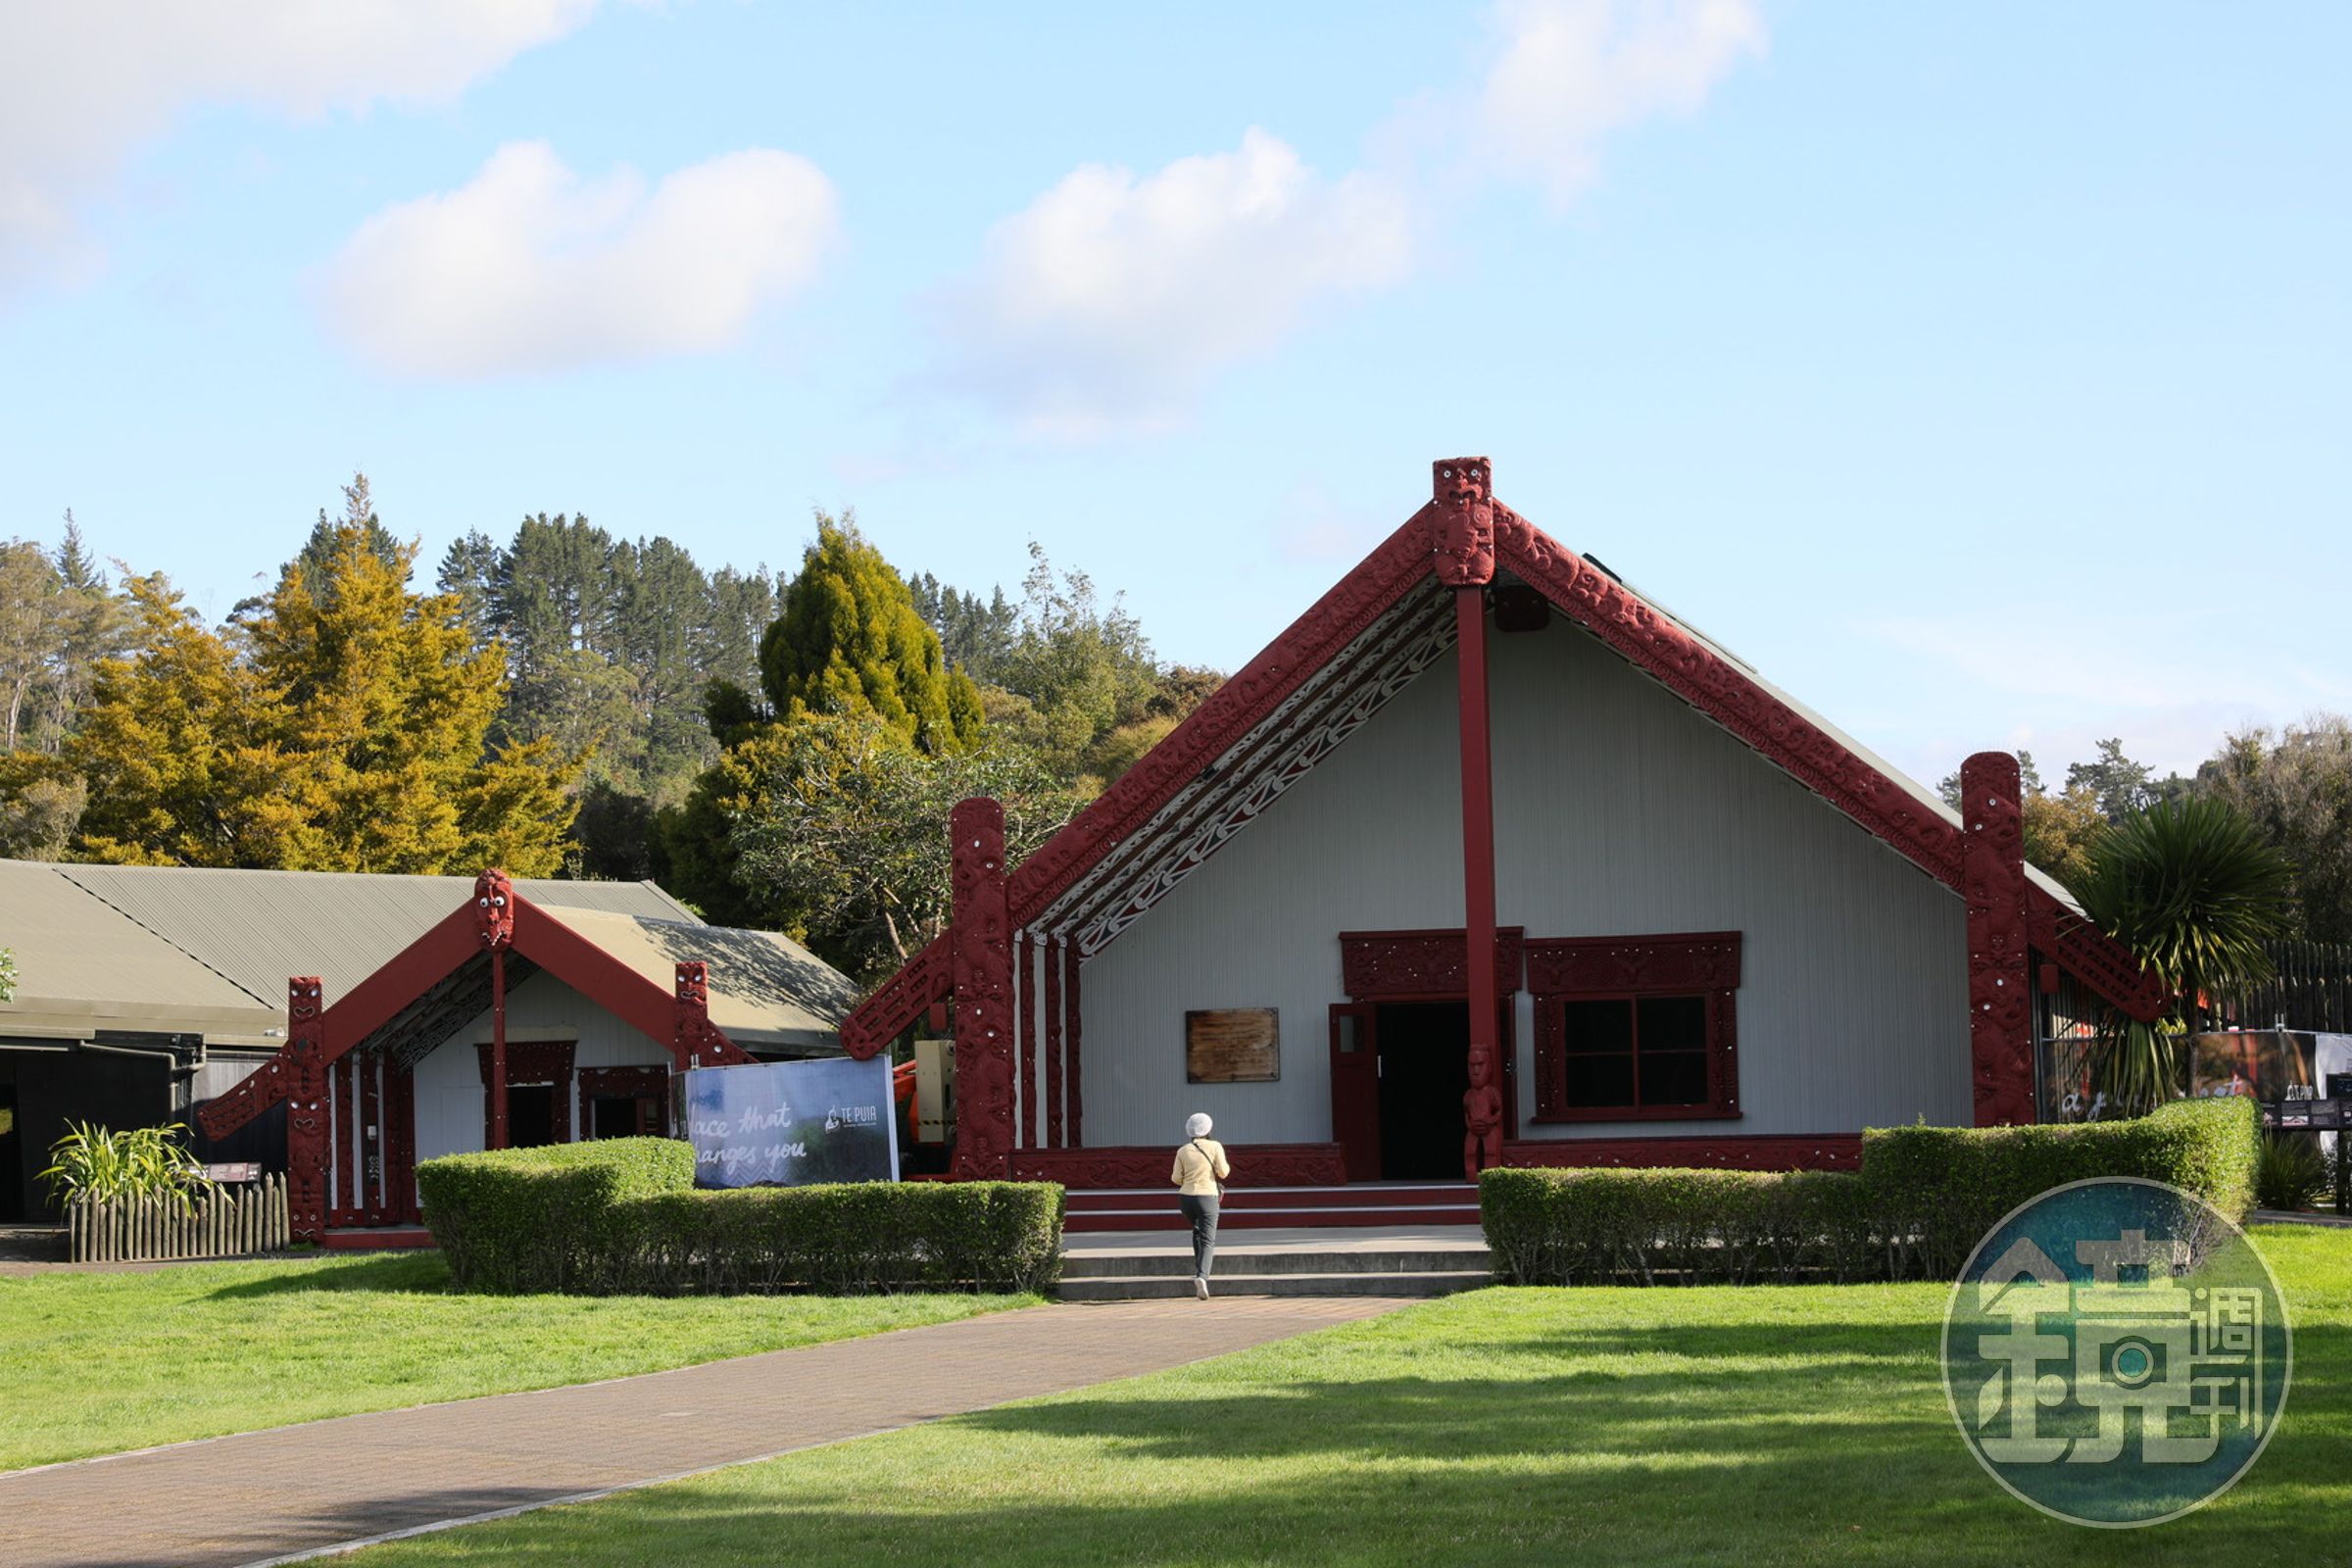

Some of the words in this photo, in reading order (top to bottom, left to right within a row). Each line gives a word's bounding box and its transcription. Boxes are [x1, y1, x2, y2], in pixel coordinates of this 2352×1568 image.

[689, 1102, 730, 1138] lace
[738, 1102, 791, 1134] that
[841, 1107, 853, 1123] TE
[855, 1105, 877, 1122] PUIA
[764, 1141, 808, 1174] you
